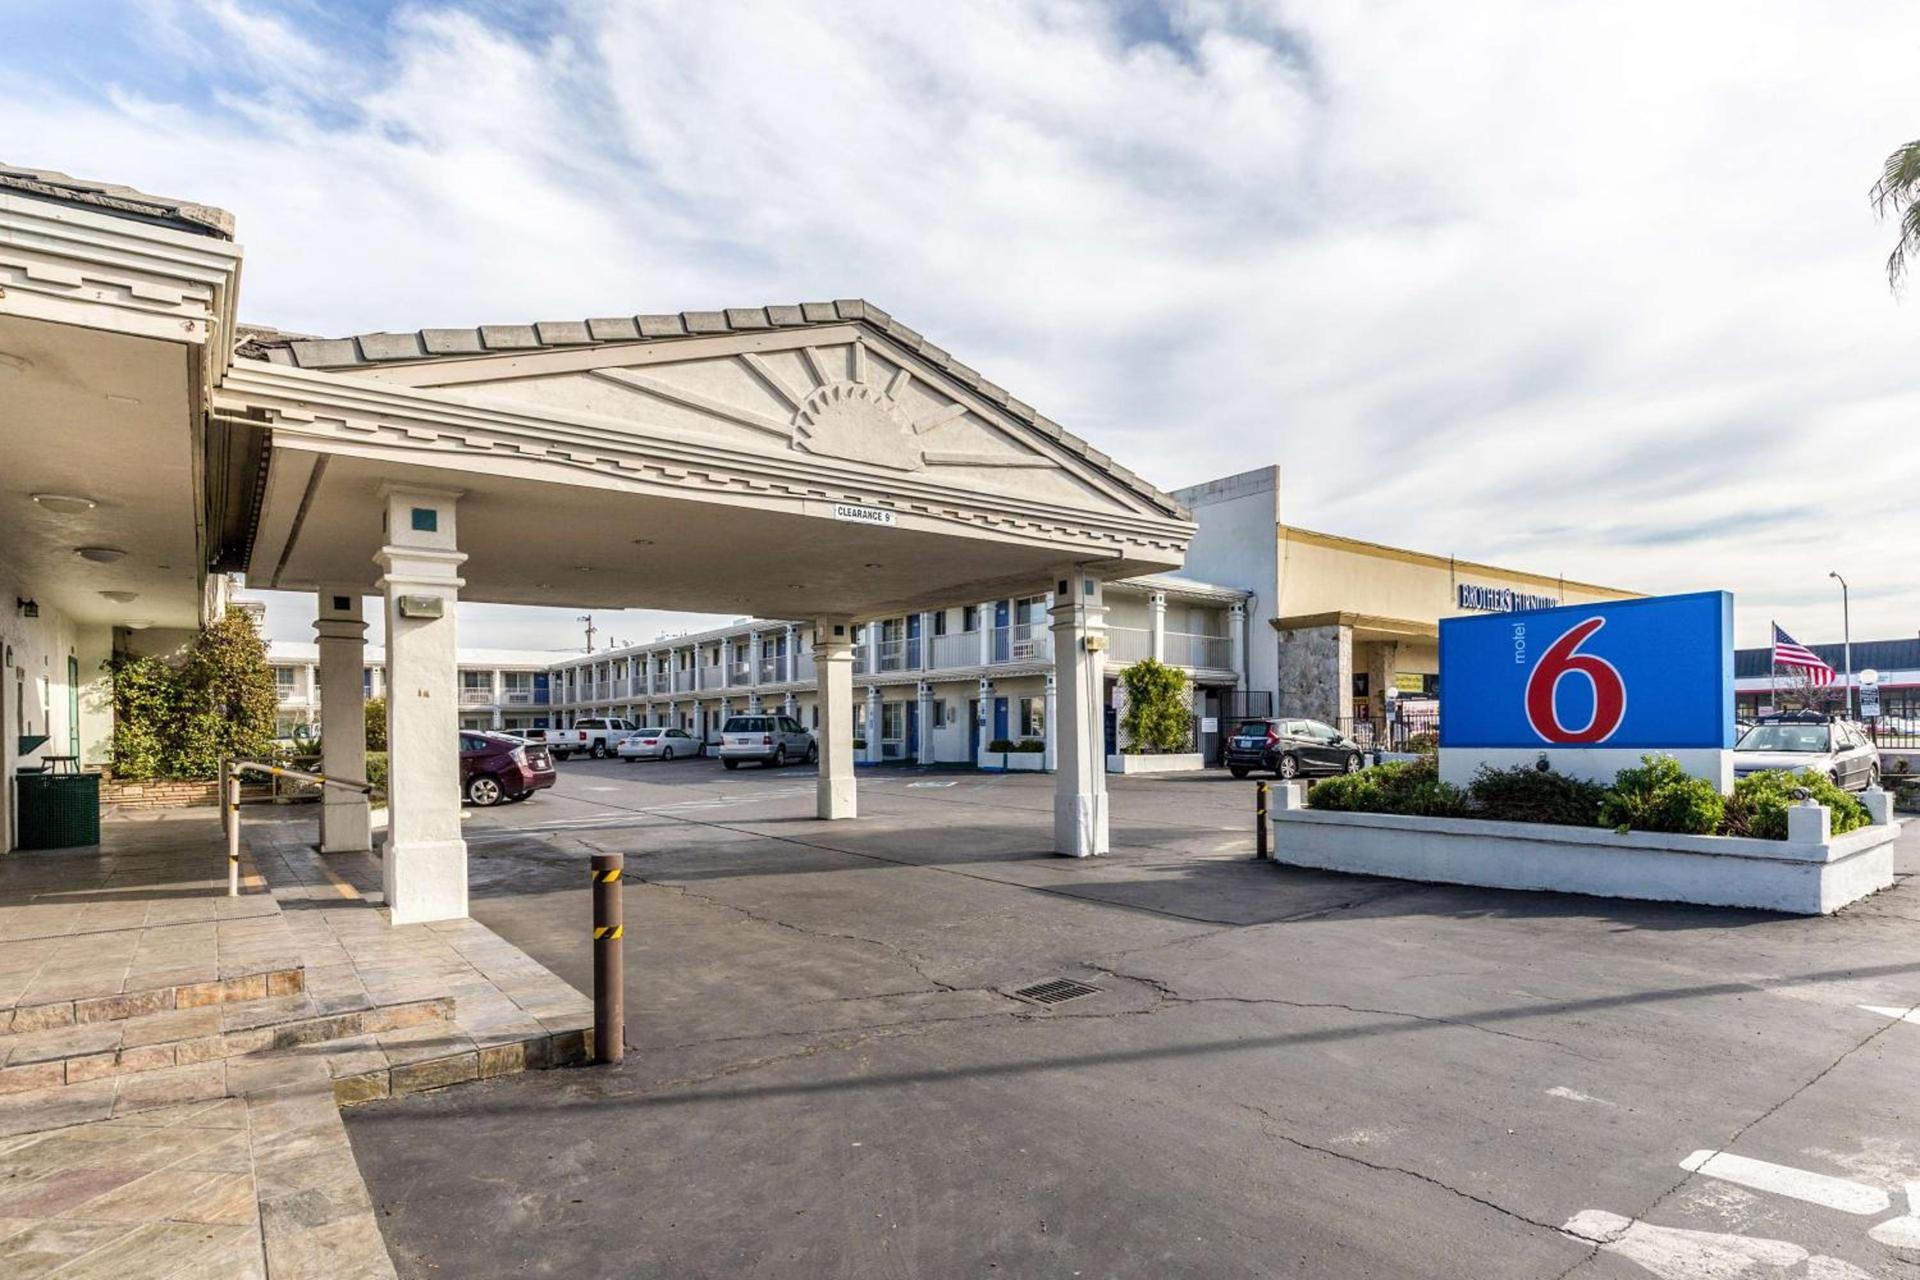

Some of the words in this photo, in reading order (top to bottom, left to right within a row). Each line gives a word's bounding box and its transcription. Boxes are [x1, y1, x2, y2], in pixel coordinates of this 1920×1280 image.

[837, 506, 883, 521] CLEARANCE
[1511, 622, 1526, 664] motel
[1524, 616, 1627, 744] 6
